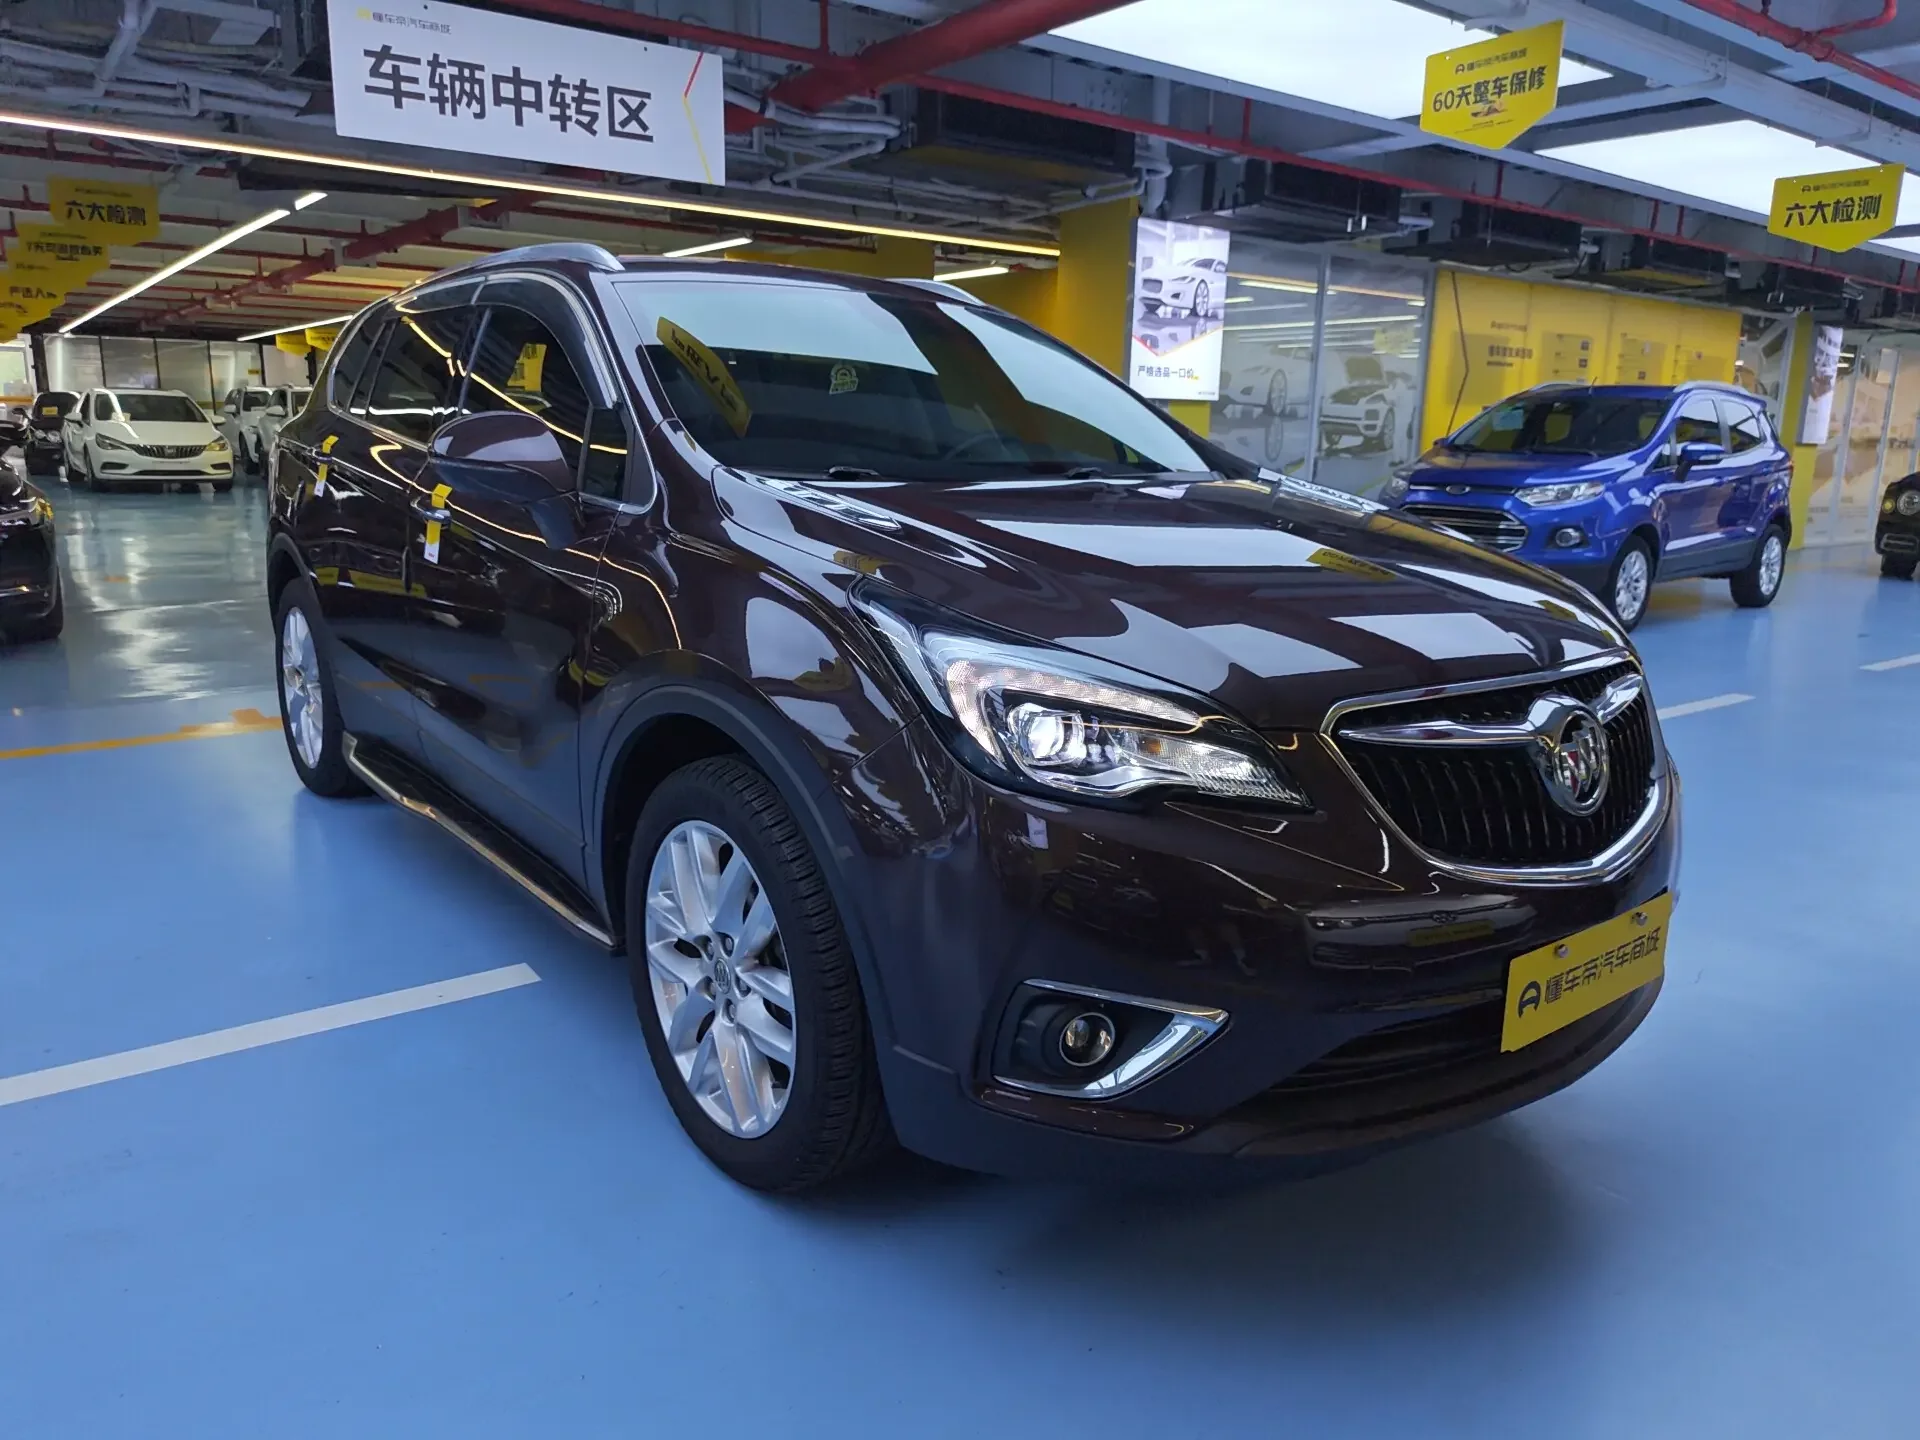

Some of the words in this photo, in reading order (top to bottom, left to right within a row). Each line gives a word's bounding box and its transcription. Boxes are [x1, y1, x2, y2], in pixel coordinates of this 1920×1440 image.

[363, 44, 655, 143] 车辆中转区
[1432, 65, 1548, 113] 60天整车保修
[65, 200, 147, 227] 六大检测
[1784, 193, 1883, 228] 六大检测
